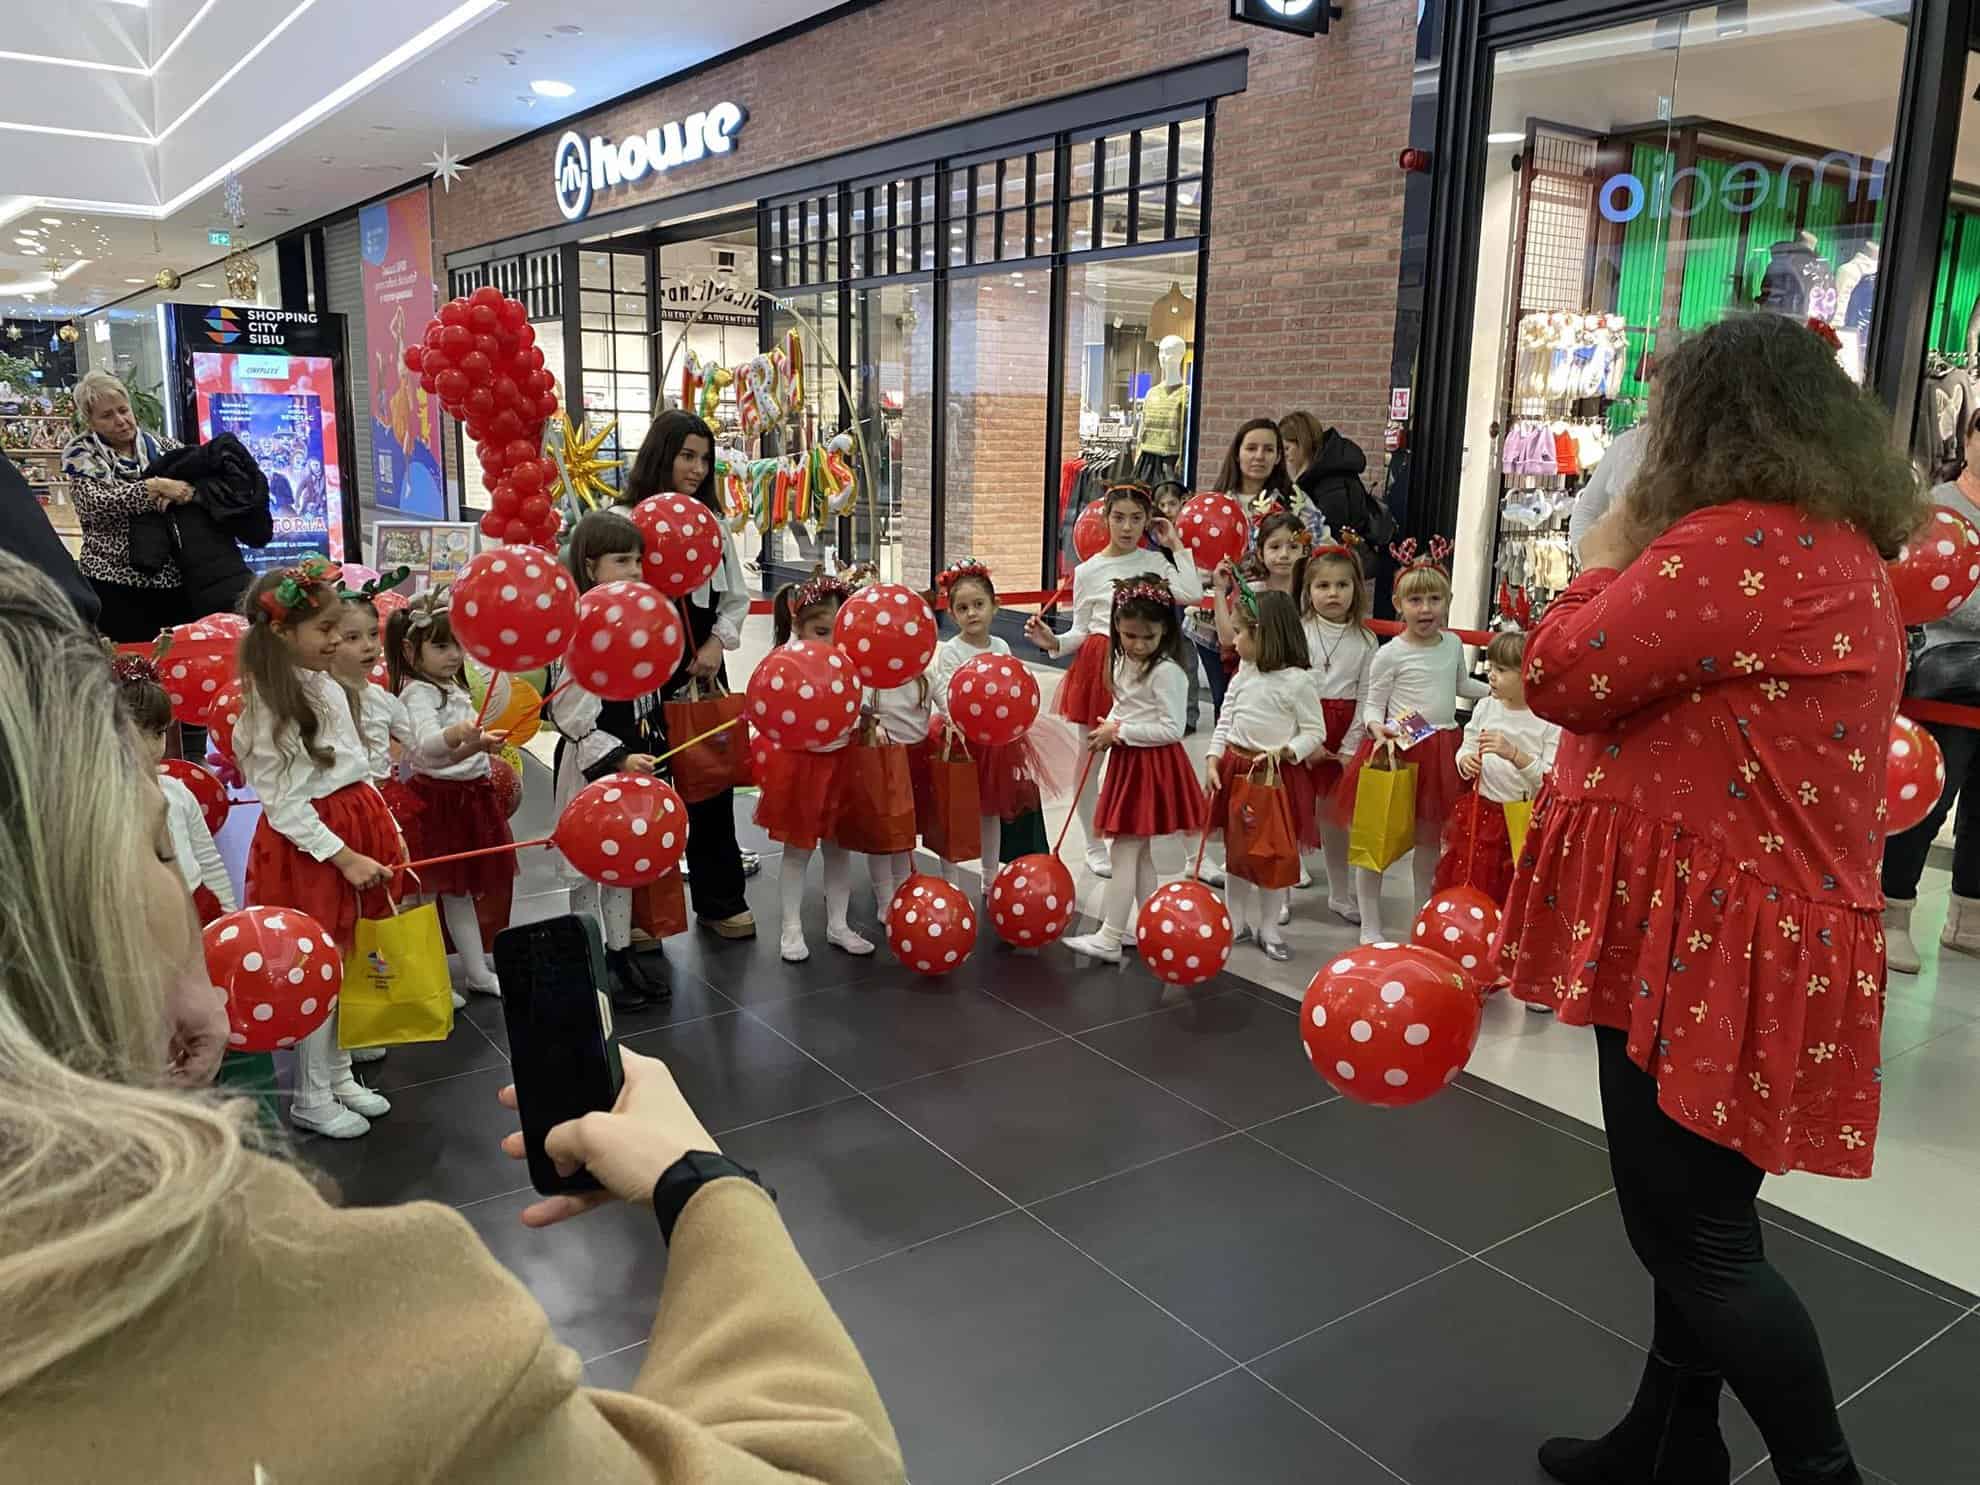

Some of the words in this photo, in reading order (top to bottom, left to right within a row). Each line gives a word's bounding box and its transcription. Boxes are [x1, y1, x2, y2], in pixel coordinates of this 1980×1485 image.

[589, 102, 746, 190] house
[247, 310, 318, 324] SHOPPING
[248, 322, 278, 333] CITY
[249, 334, 285, 345] SIBIU
[271, 516, 328, 533] TORIA
